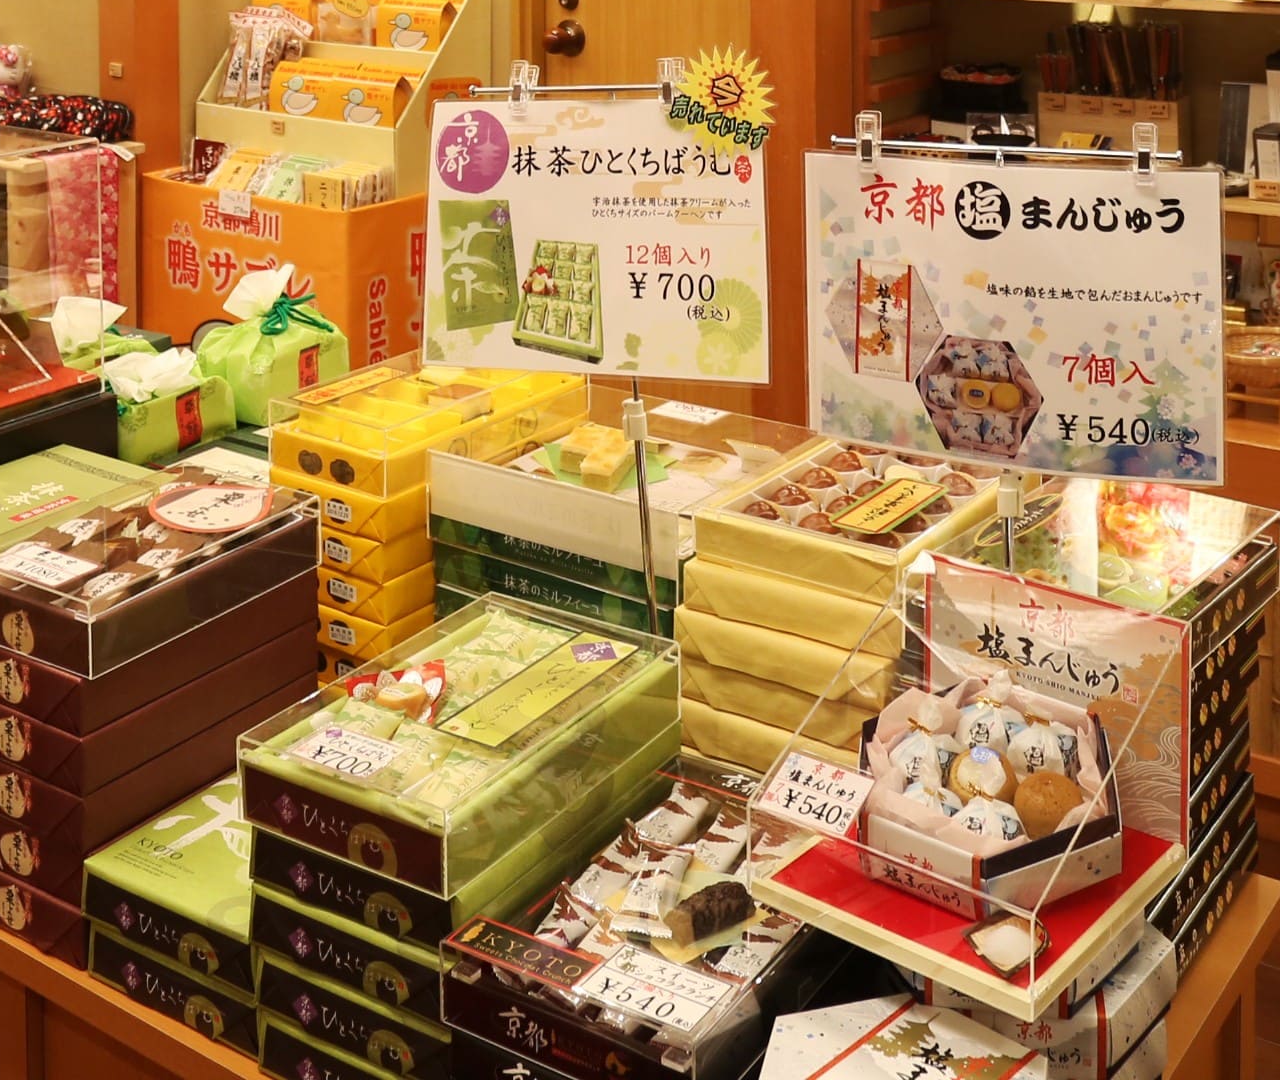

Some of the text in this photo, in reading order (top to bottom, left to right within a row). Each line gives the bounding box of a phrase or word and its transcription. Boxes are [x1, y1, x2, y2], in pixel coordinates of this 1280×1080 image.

[670, 94, 770, 151] 売れています
[441, 113, 481, 182] 京都
[512, 145, 733, 178] 抹茶ひとくちばうむ
[173, 221, 192, 237] かも
[625, 242, 713, 269] 12個入り
[629, 271, 717, 303] ¥700
[686, 304, 732, 323] (税込)
[1062, 354, 1155, 388] 7個入
[1057, 413, 1201, 448] ¥540 (税込)
[504, 572, 605, 617] 抹茶のミルフィーユ
[1019, 598, 1075, 648] 京都
[977, 624, 1120, 694] 塩まんじゅう
[1016, 669, 1044, 686] KYOTO
[1045, 677, 1067, 692] SHIO
[309, 745, 373, 777] ¥700
[811, 762, 844, 782] 京都
[788, 767, 856, 801] 塩まんじゅう
[783, 789, 842, 826] ¥540
[135, 836, 184, 861] KYOTO
[481, 930, 584, 979] KYOTO
[652, 964, 716, 993] スイーツ
[598, 976, 676, 1019] ¥540
[499, 1007, 549, 1055] 京都
[1015, 1021, 1053, 1045] 京都
